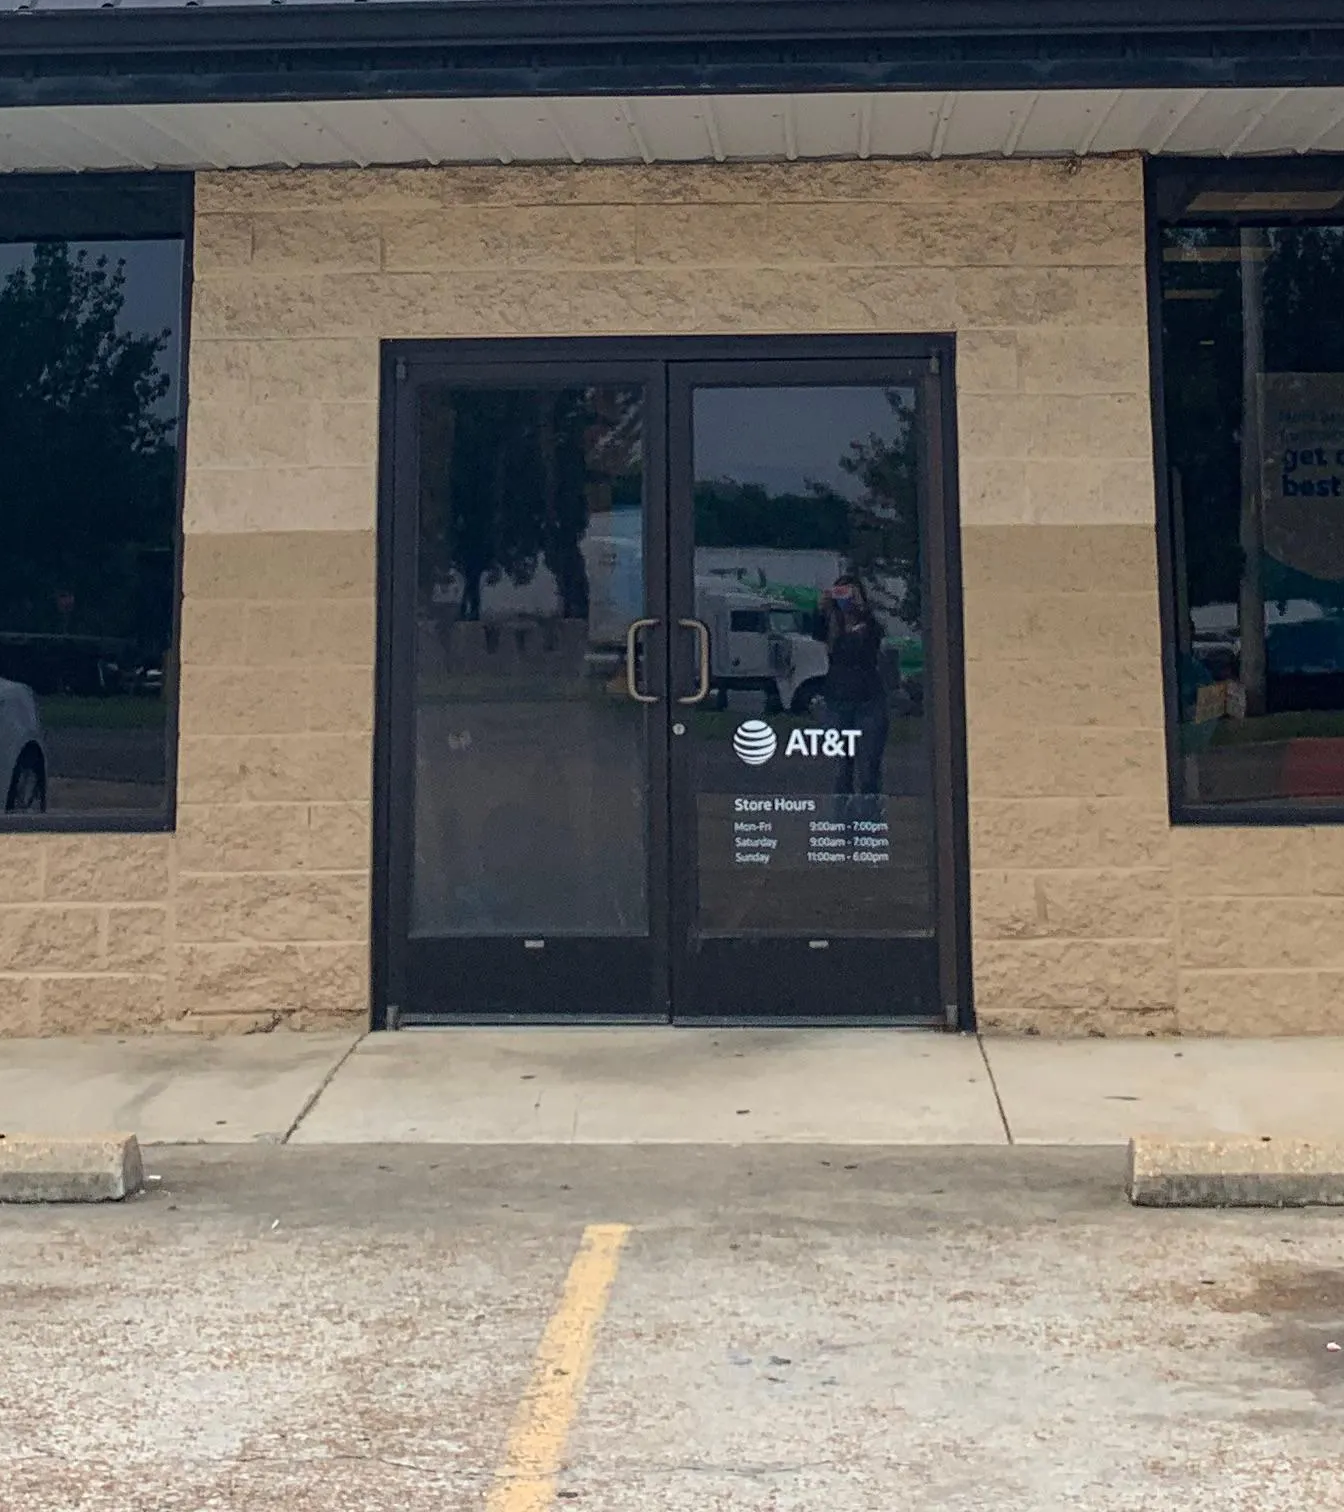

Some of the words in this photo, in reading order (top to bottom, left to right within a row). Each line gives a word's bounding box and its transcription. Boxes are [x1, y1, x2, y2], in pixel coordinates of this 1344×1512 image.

[1282, 448, 1327, 472] get
[1282, 474, 1341, 496] best
[785, 729, 862, 757] AT&T
[734, 798, 772, 811] Store
[774, 798, 815, 811] Hours
[734, 821, 772, 831] Mon-Fri
[735, 837, 778, 849] Saturday
[735, 852, 770, 864] Sunday
